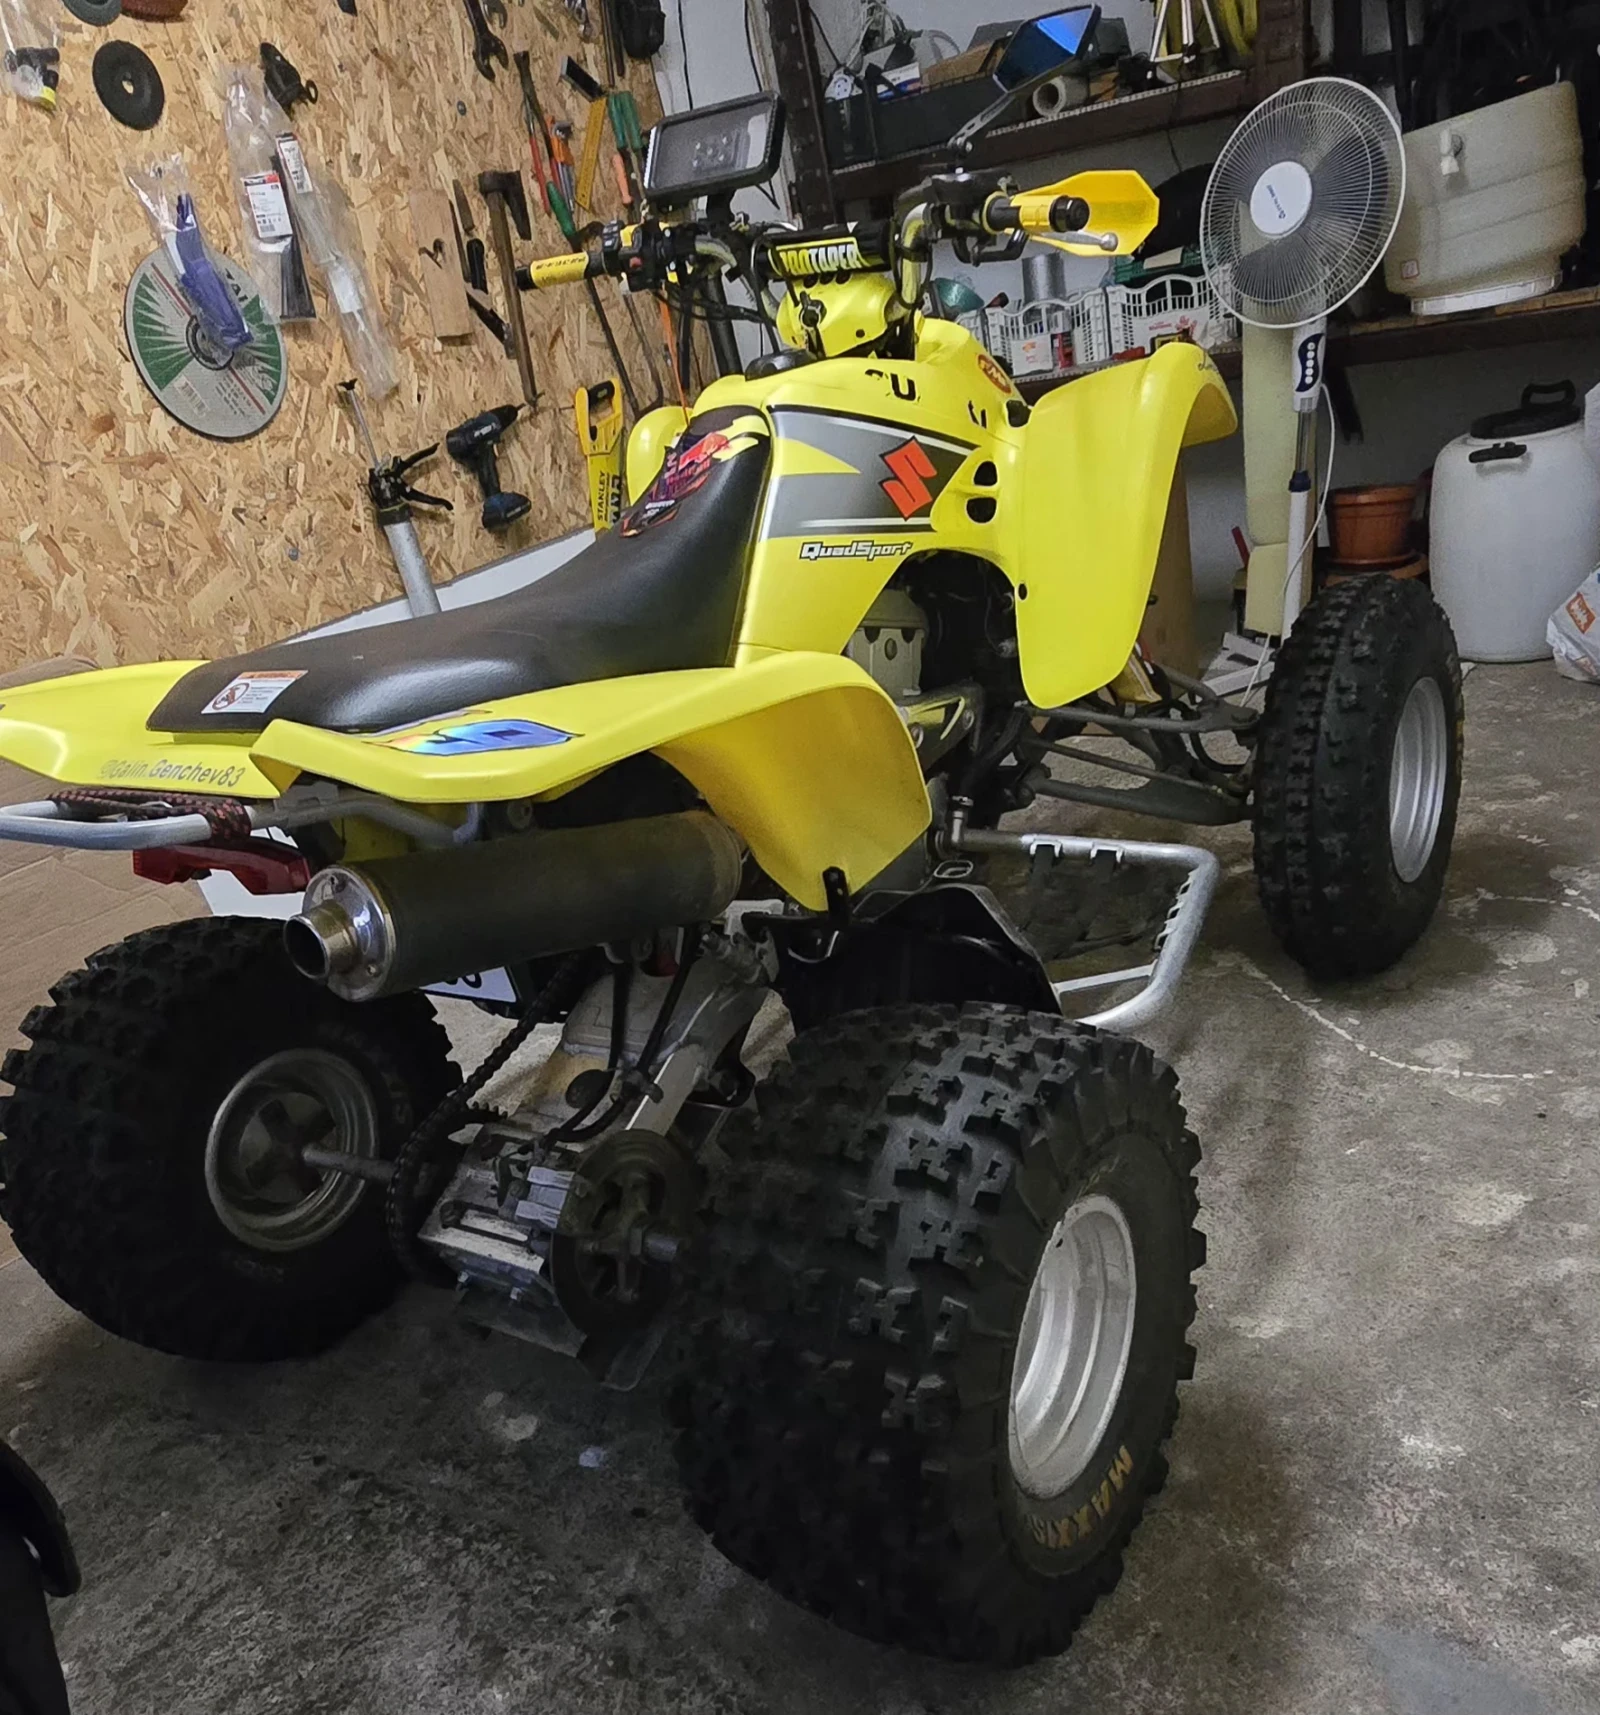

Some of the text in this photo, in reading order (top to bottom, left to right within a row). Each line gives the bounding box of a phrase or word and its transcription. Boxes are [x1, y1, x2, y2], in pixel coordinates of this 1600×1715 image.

[597, 470, 606, 521] STANLEY
[800, 540, 913, 561] QuadSport
[99, 758, 246, 787] @Galin.Genchev83
[1030, 1444, 1134, 1549] MAXXIS
